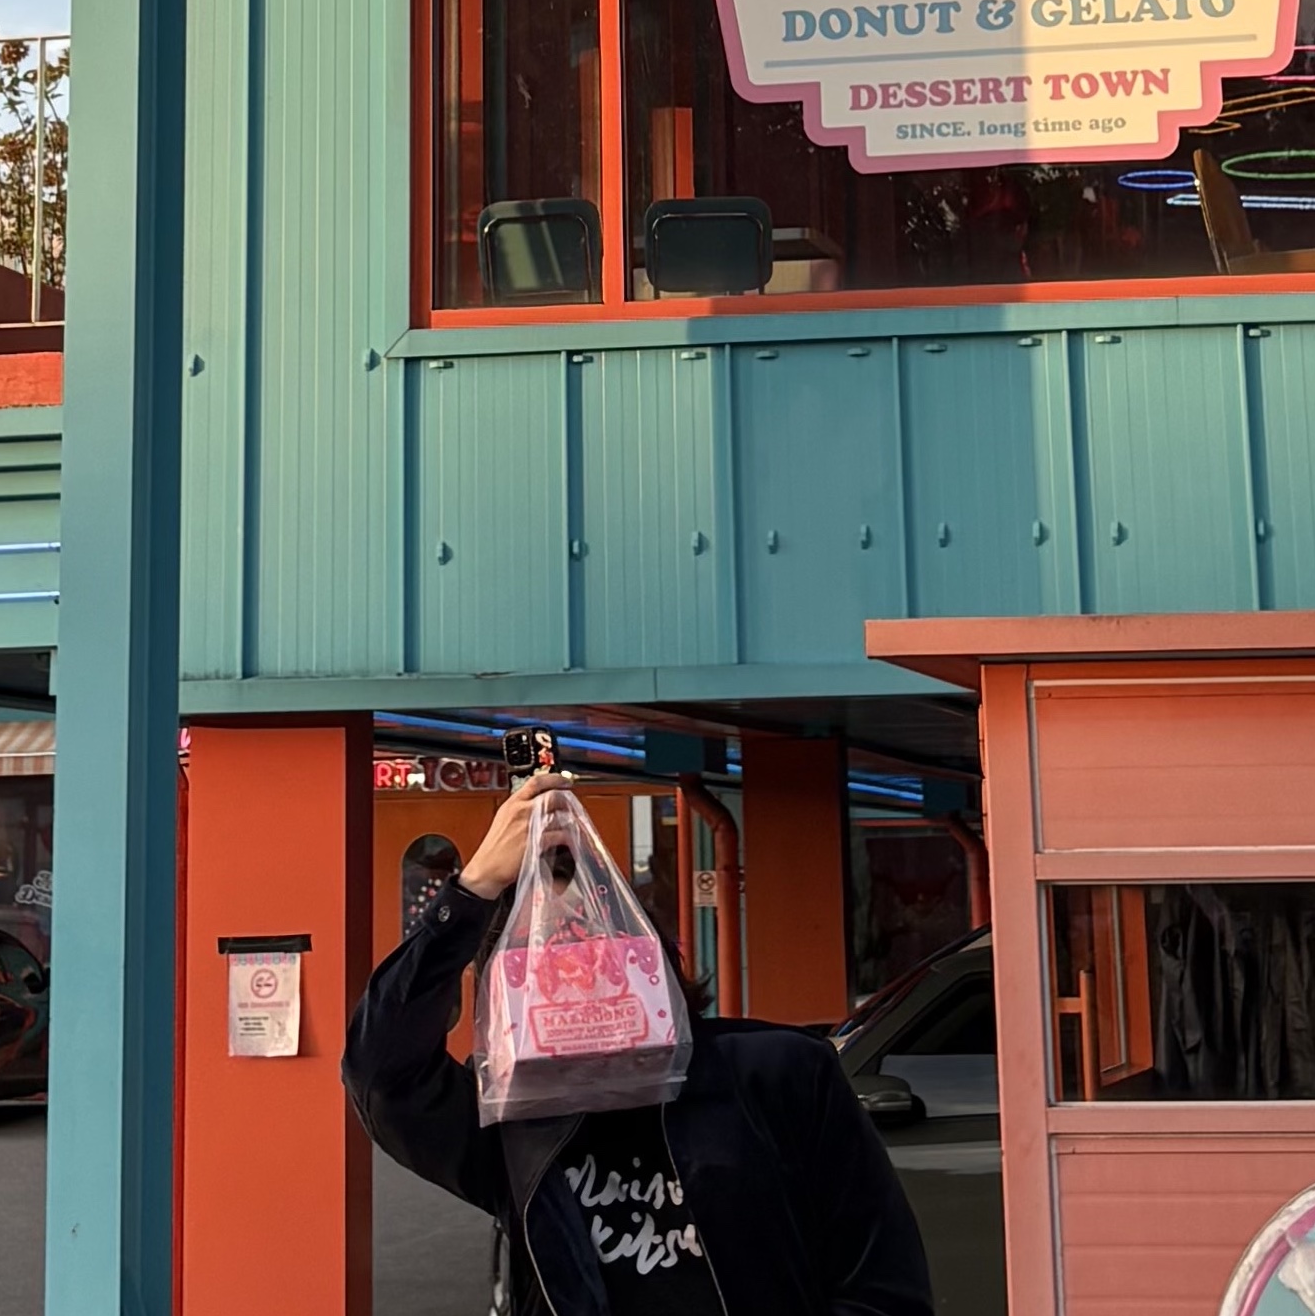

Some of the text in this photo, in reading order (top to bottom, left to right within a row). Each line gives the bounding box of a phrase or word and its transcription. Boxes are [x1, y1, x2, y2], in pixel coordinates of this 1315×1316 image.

[782, 0, 961, 42] DONUT
[849, 67, 1171, 111] DESSERT TOWN
[896, 116, 1127, 141] SINCE. long time ago
